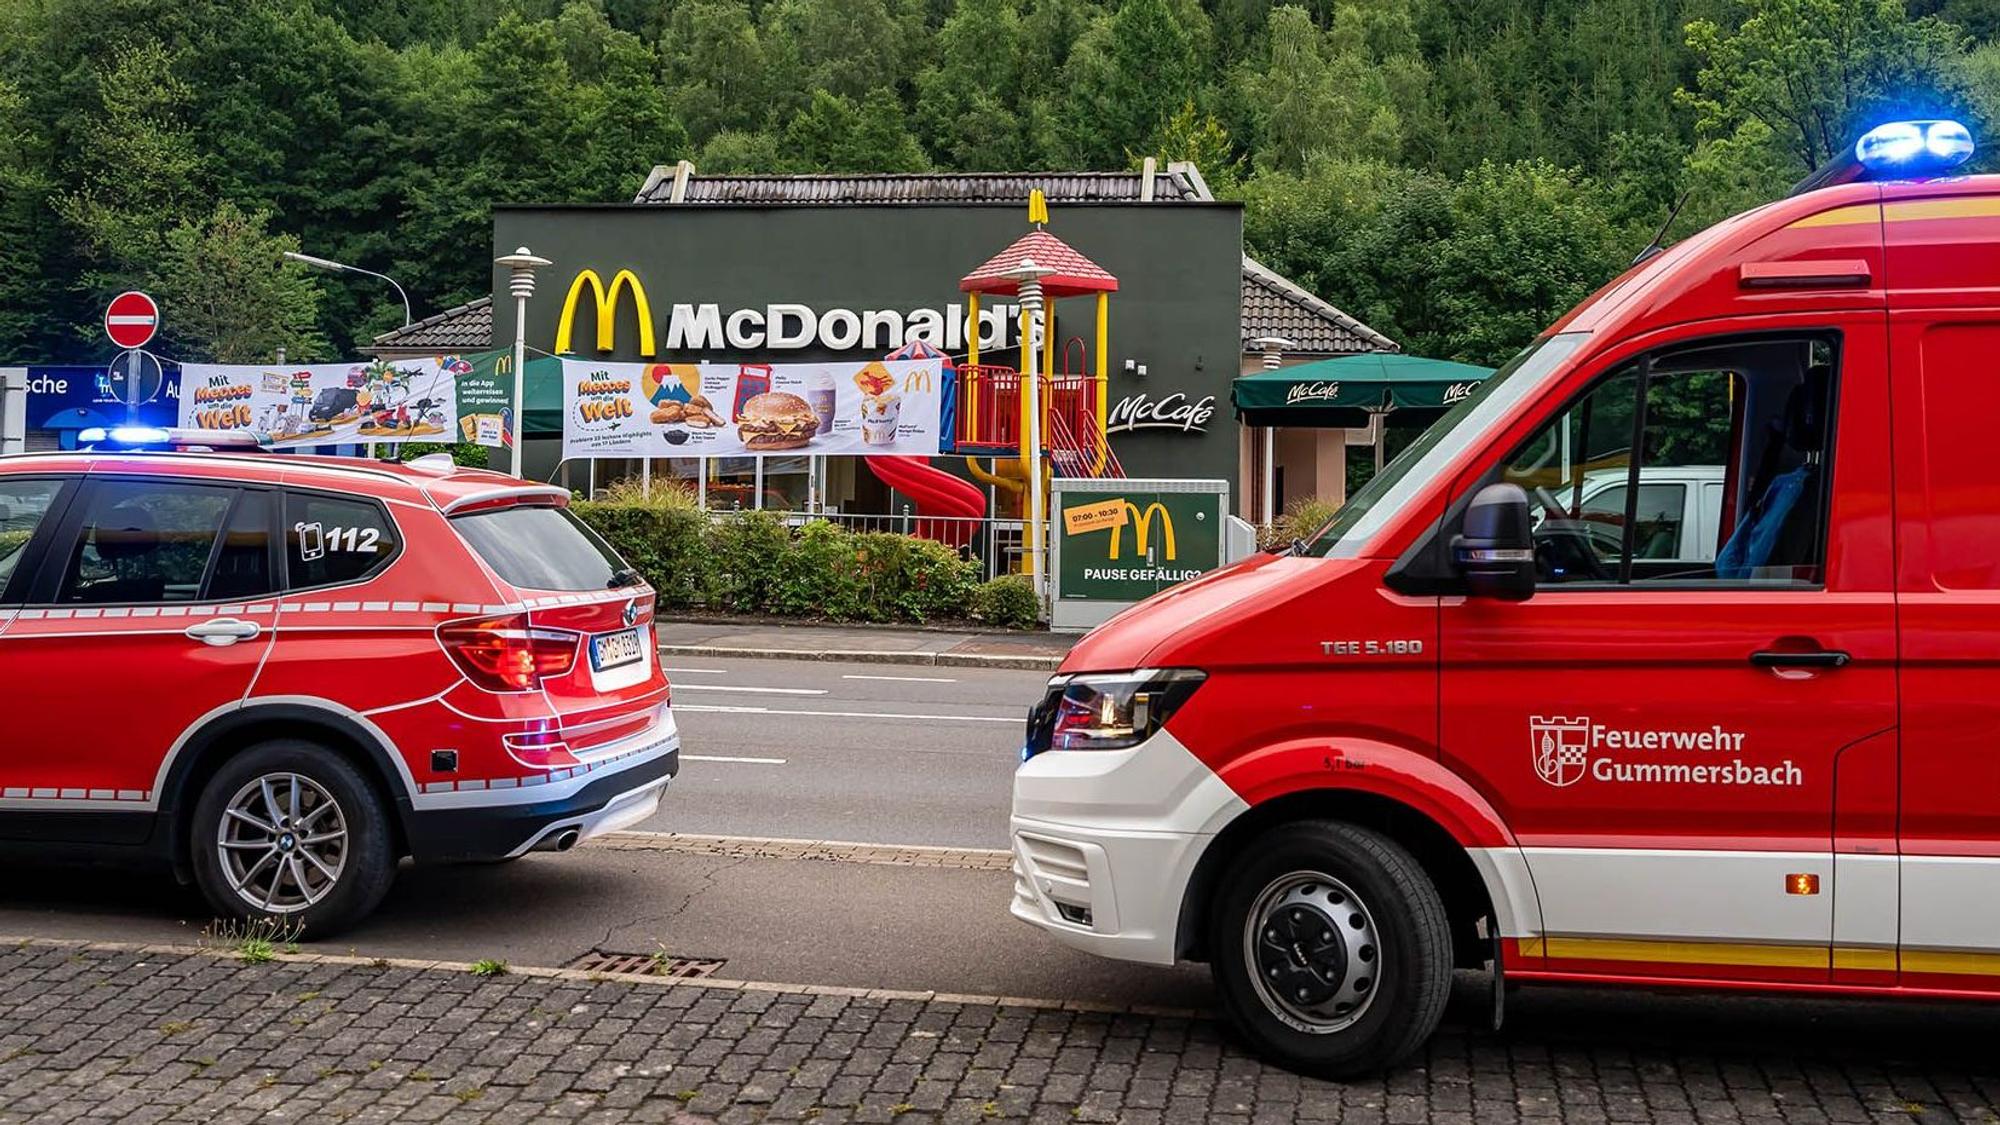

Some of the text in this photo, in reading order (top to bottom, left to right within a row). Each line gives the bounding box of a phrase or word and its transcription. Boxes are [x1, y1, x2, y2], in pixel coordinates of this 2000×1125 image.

[208, 375, 230, 388] Mit
[480, 380, 494, 388] App
[590, 370, 610, 382] Mit
[194, 384, 252, 404] Mecces
[578, 381, 631, 397] Mecces
[196, 404, 252, 430] Welt
[580, 396, 633, 423] Welt
[1072, 512, 1093, 523] 07:00
[1098, 508, 1118, 518] 10:30
[325, 527, 379, 552] 112
[1084, 566, 1202, 581] PAUSE GEFÄLLIG?
[1320, 640, 1423, 655] TGE 5.180
[1592, 725, 1745, 751] Feuerwehr
[1592, 758, 1803, 785] Gummersbach
